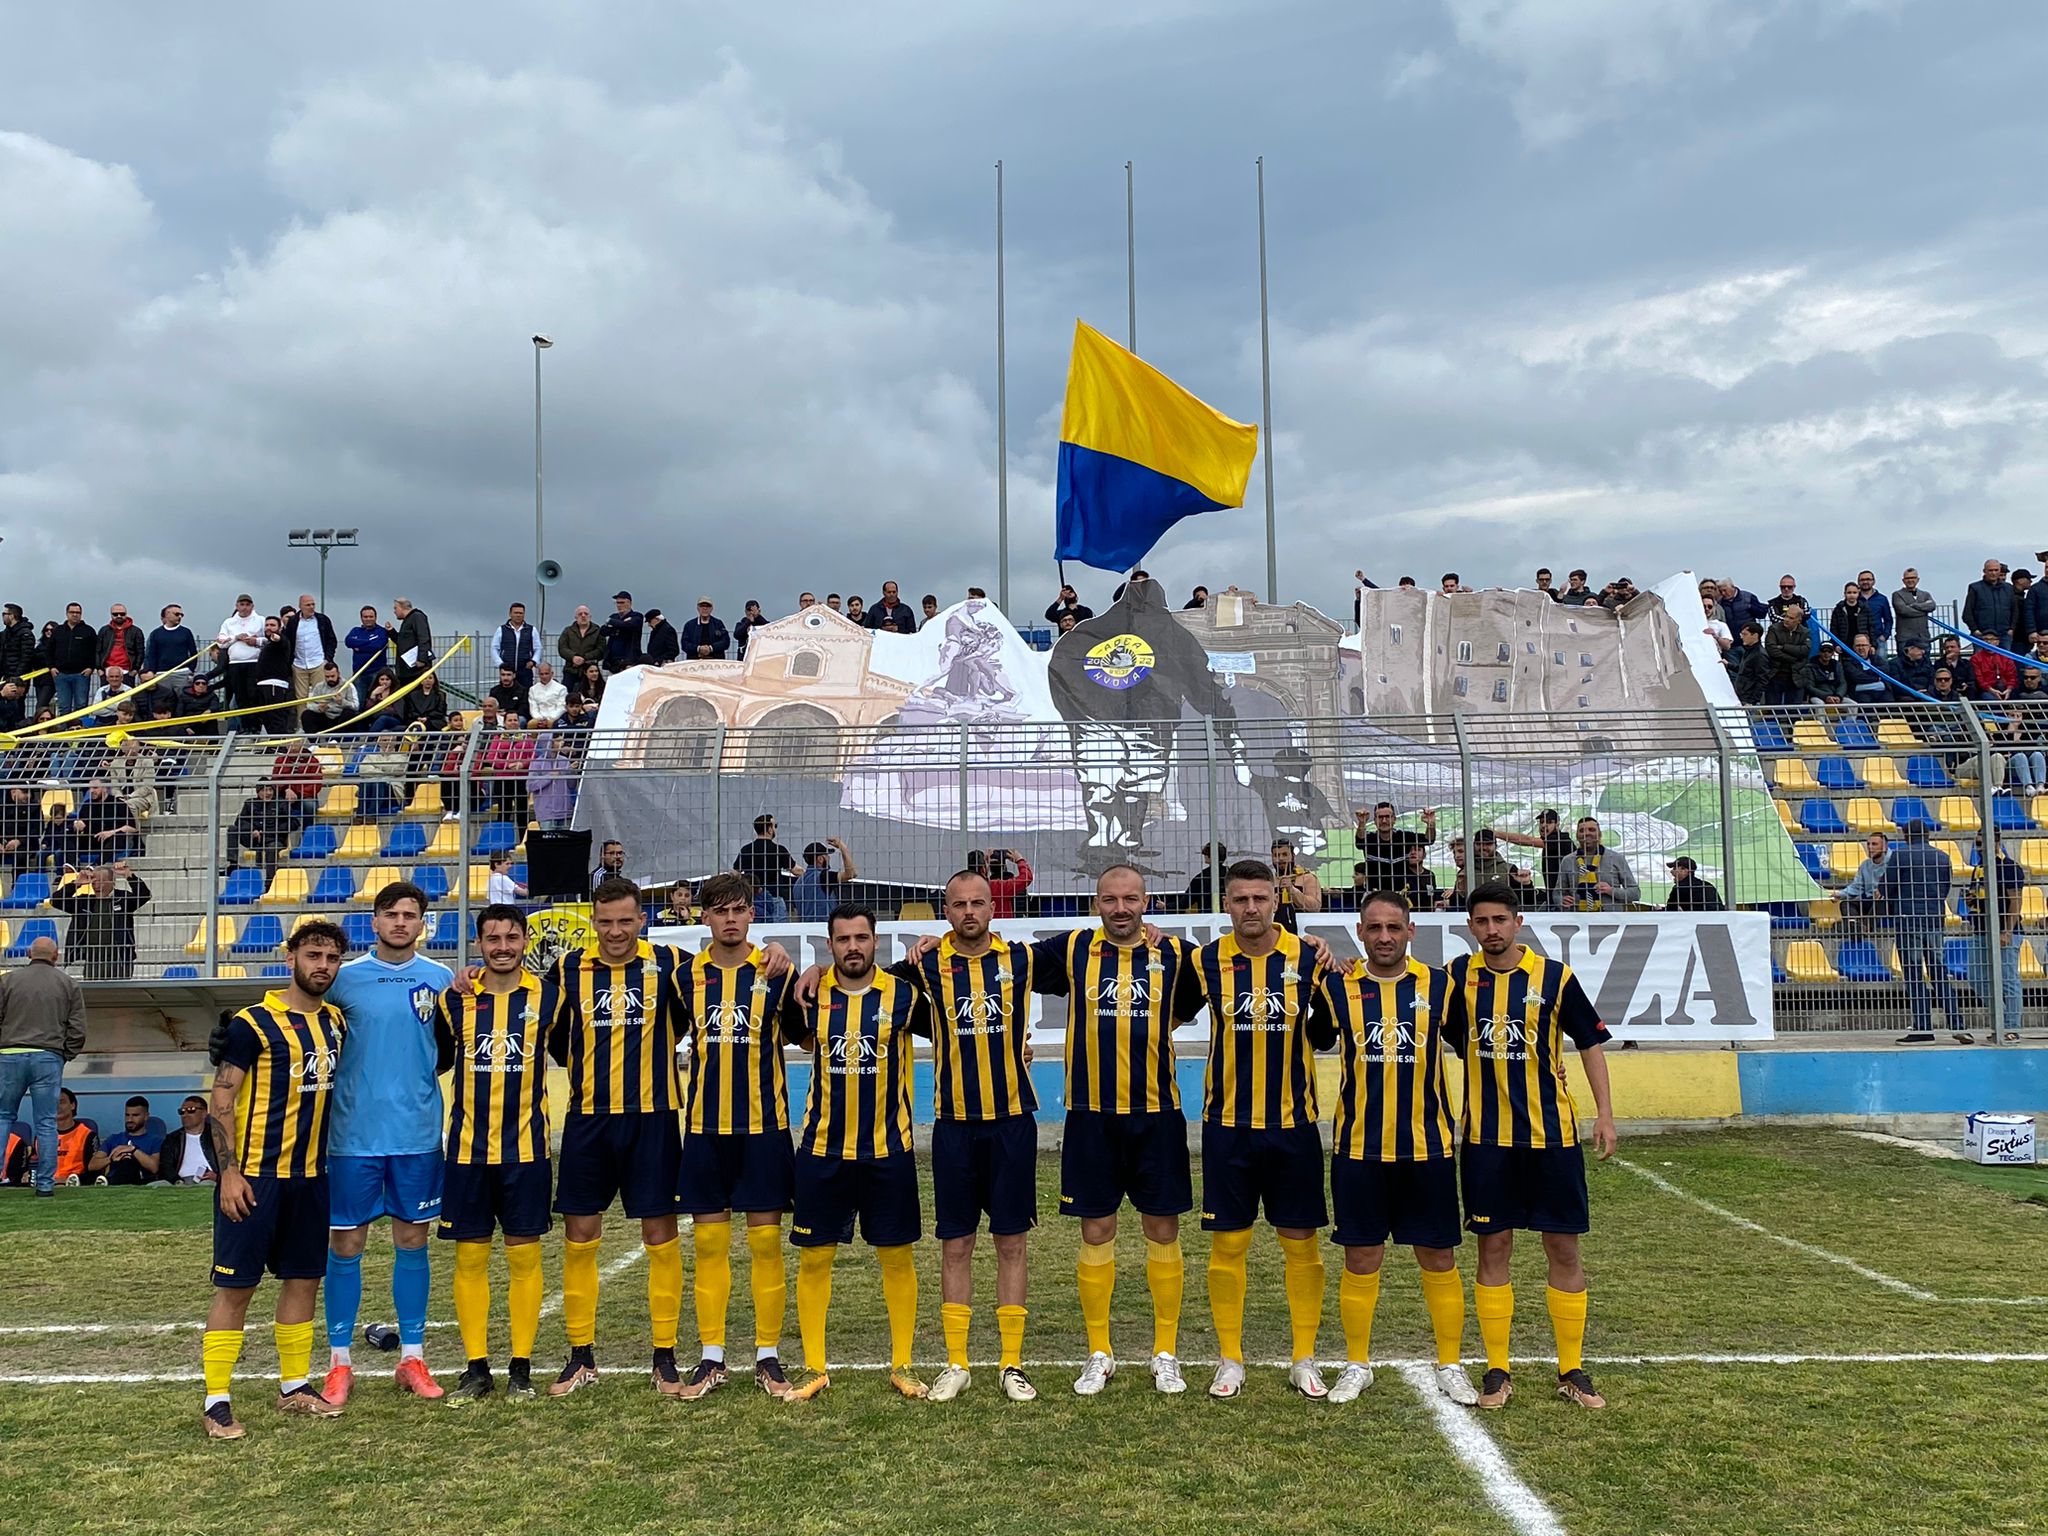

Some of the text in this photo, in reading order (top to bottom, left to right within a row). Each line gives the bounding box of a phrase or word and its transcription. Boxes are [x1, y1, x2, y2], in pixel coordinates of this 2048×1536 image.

[1104, 637, 1142, 651] AREA
[1093, 671, 1140, 687] NUOVA
[527, 917, 586, 941] AREA
[1093, 1008, 1154, 1017] EMME DUE SRL
[589, 1019, 613, 1028] EMME
[614, 1018, 632, 1026] DUE
[1231, 1023, 1292, 1032] EMME DUE SRL
[953, 1023, 1008, 1036] EMME DUE SRL
[723, 1035, 739, 1043] DUE
[1360, 1055, 1420, 1064] EMME DUE SRL
[1497, 1051, 1515, 1060] DUE
[1516, 1052, 1532, 1060] SRL
[512, 1064, 528, 1072] SRL
[848, 1066, 866, 1075] DUE
[866, 1066, 881, 1074] SRL
[1986, 1133, 2030, 1156] Sixtus
